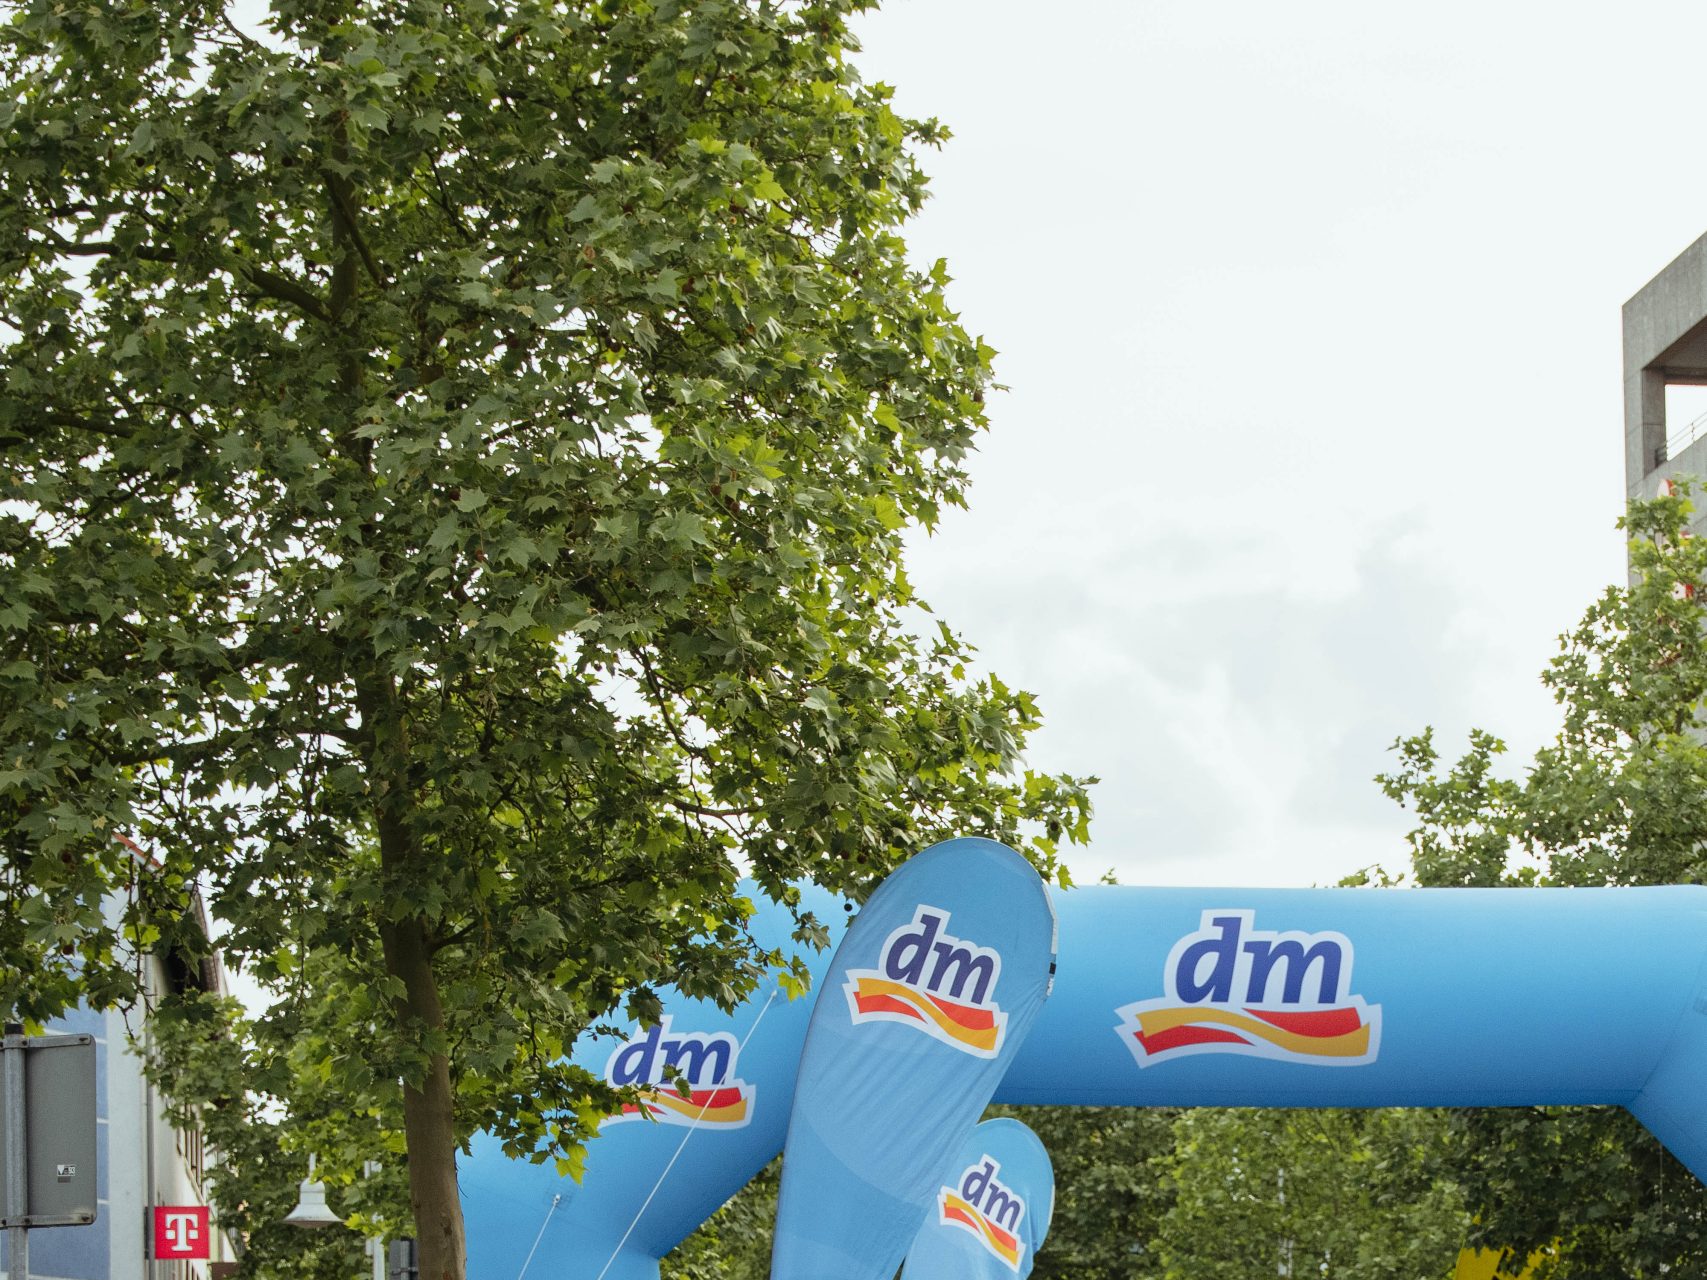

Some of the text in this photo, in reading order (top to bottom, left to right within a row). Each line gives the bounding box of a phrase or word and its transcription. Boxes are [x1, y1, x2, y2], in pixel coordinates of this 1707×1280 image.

[886, 914, 994, 1006] dm
[1175, 916, 1343, 1005] dm
[612, 1022, 731, 1086] dm
[165, 1213, 199, 1252] T
[962, 1161, 1021, 1233] dm
